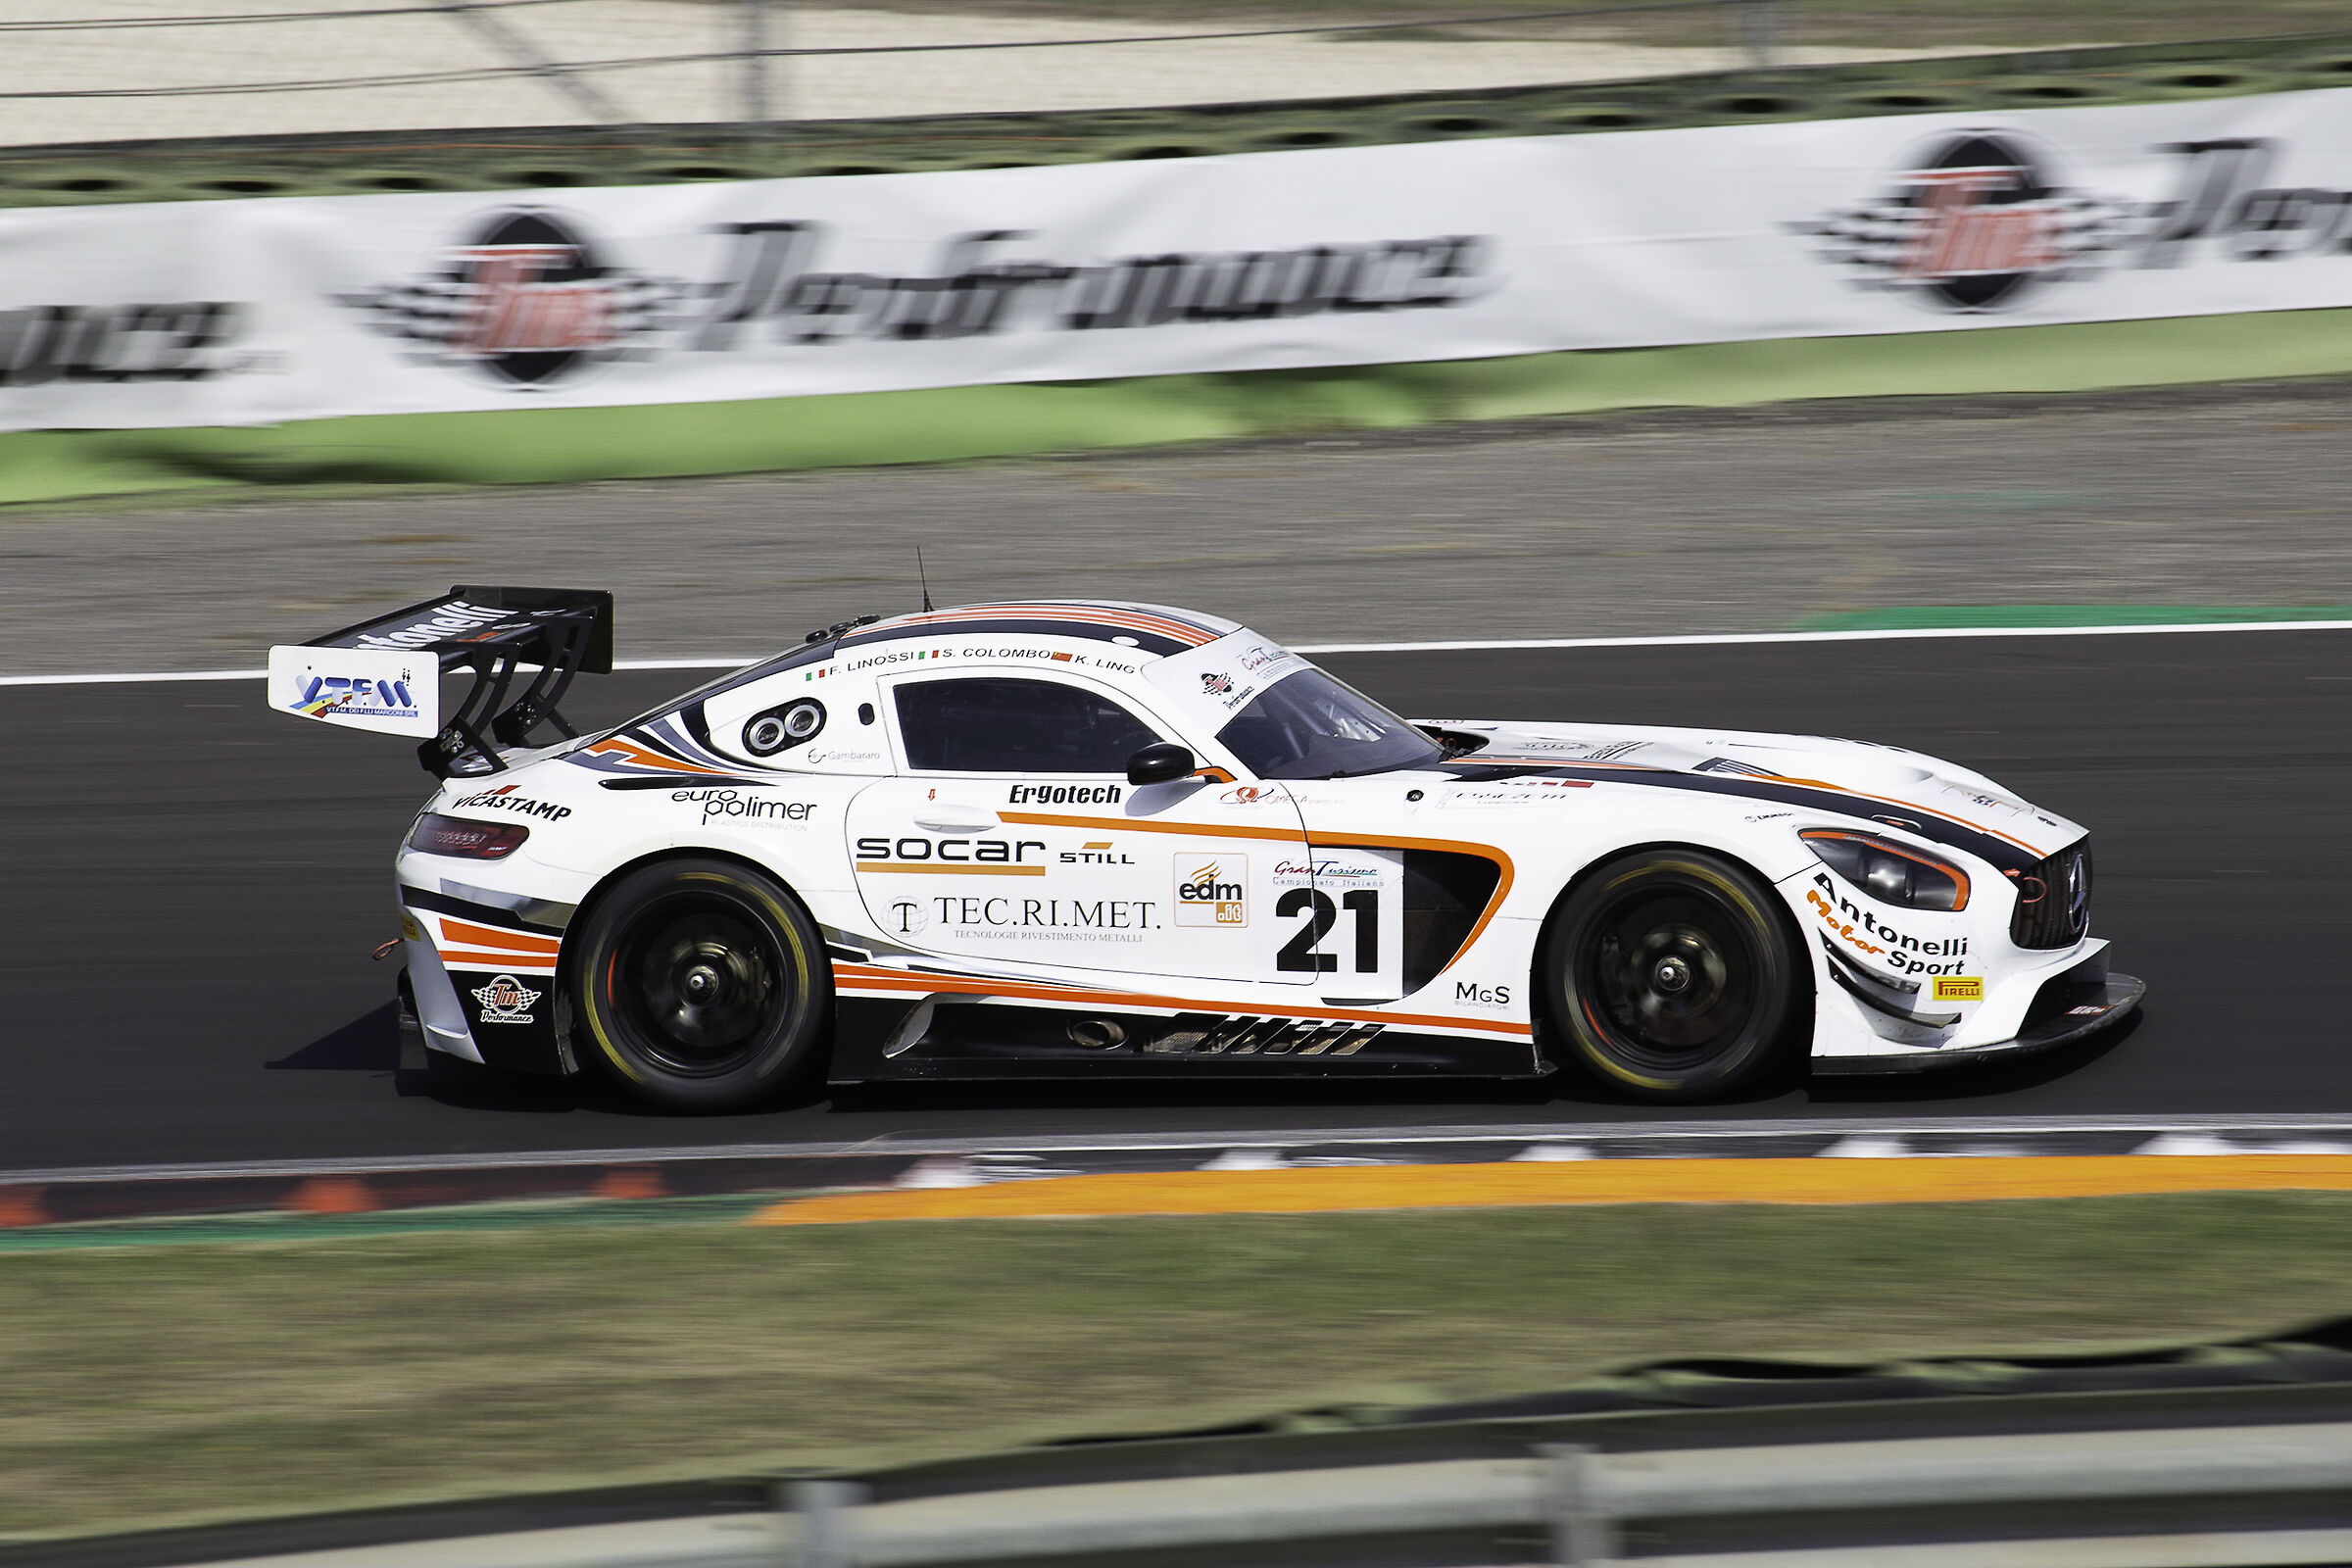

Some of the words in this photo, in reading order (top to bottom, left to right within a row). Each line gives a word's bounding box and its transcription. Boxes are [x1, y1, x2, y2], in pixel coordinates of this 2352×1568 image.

[829, 665, 842, 675] F.
[847, 651, 914, 672] LINOSSI
[942, 648, 956, 658] S.
[962, 648, 1052, 660] COLOMBO
[1074, 655, 1090, 665] K.
[1096, 659, 1136, 674] LING
[671, 790, 739, 803] euro
[1008, 784, 1122, 805] Ergotech
[452, 794, 572, 822] VICASTAMP
[702, 796, 818, 826] polimer
[1059, 852, 1136, 865] STILL
[1179, 874, 1243, 901] edm
[1343, 879, 1385, 888] Italiano
[933, 896, 1162, 931] TEC.RI.MET.
[1813, 872, 1968, 956] Antonelli
[954, 929, 1019, 940] TECNOLOGIE
[1021, 931, 1097, 942] RIVESTIMENTO
[1099, 933, 1144, 943] METALLI
[1275, 887, 1379, 973] 21
[1806, 889, 1886, 955] Motor
[1886, 950, 1966, 976] Sport
[1937, 981, 1980, 997] PIRELLI
[480, 1009, 534, 1024] Performance
